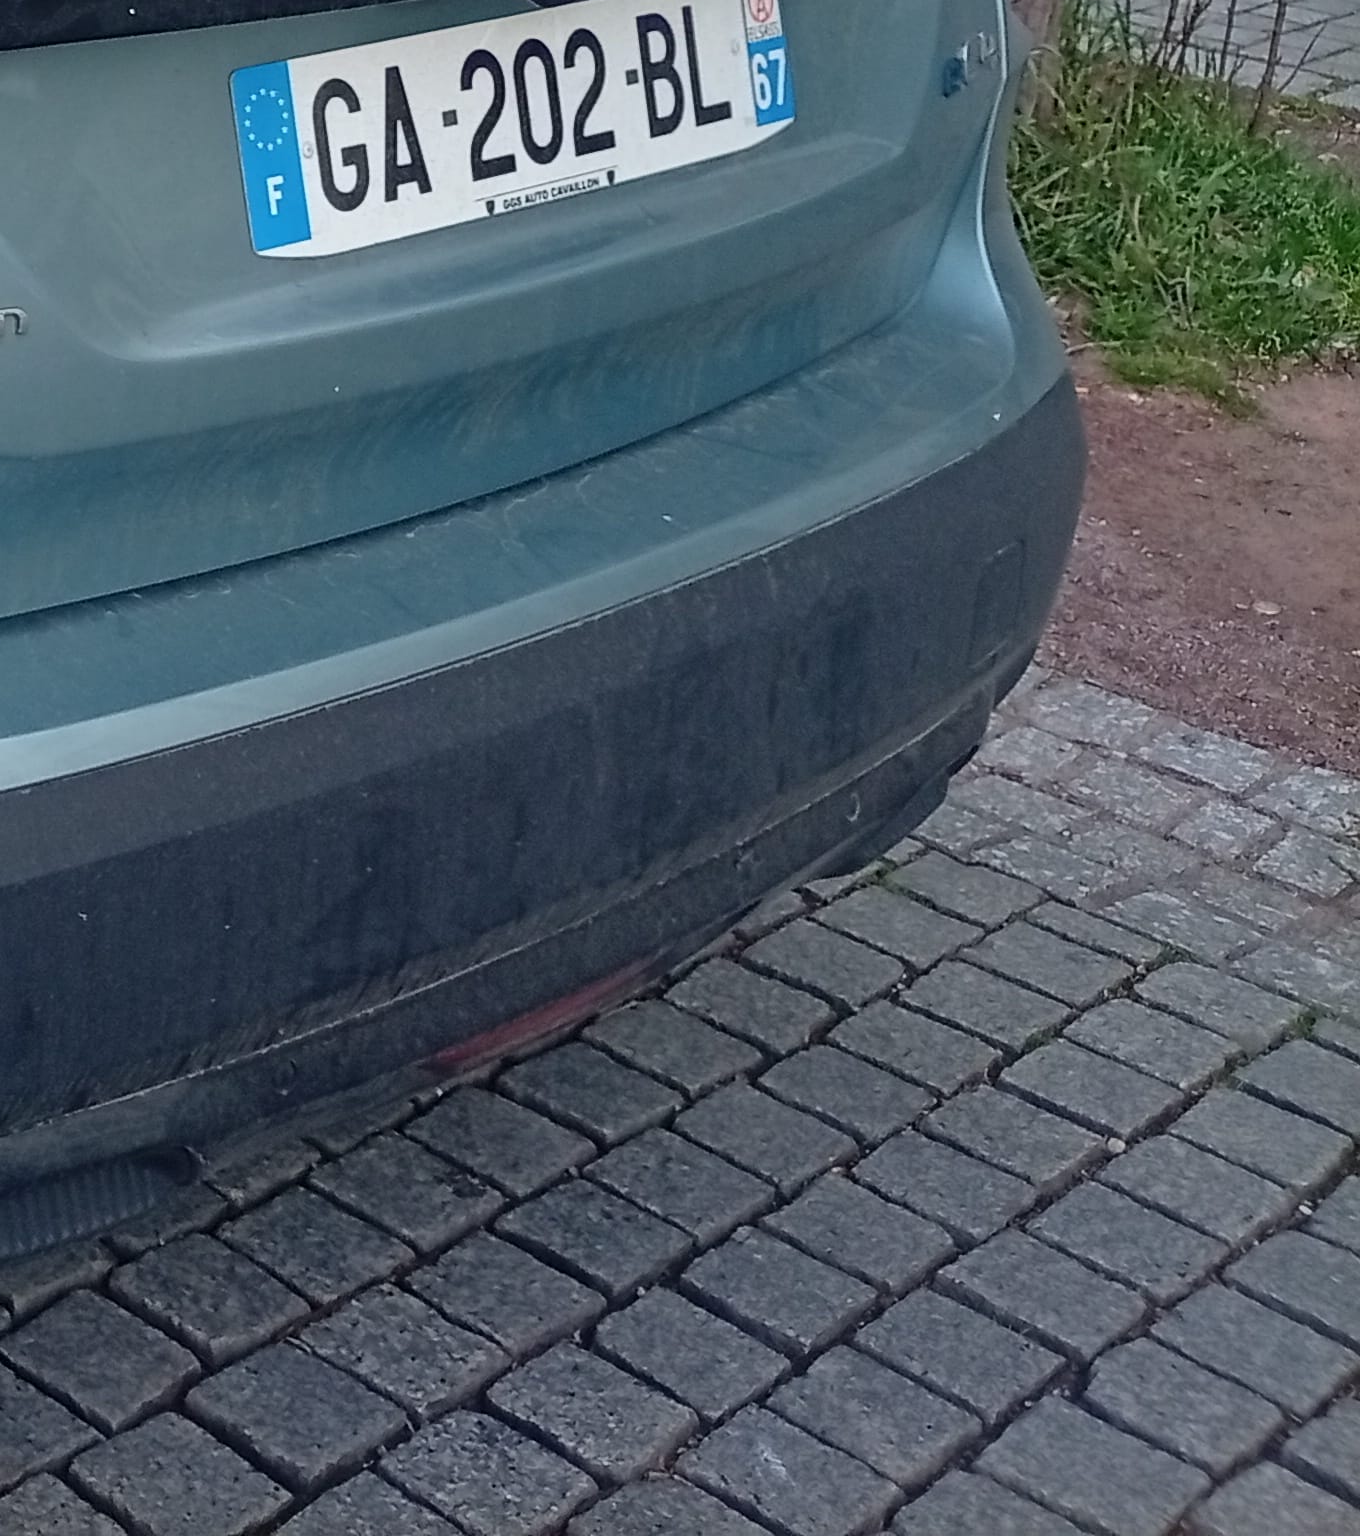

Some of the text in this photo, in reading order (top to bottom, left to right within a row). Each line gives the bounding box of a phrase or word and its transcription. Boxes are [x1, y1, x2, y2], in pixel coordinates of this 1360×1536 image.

[751, 47, 787, 112] 67
[311, 5, 733, 212] GA-202-BL
[264, 173, 285, 217] F
[524, 189, 549, 204] AUTO
[550, 177, 600, 197] CAVAILLON
